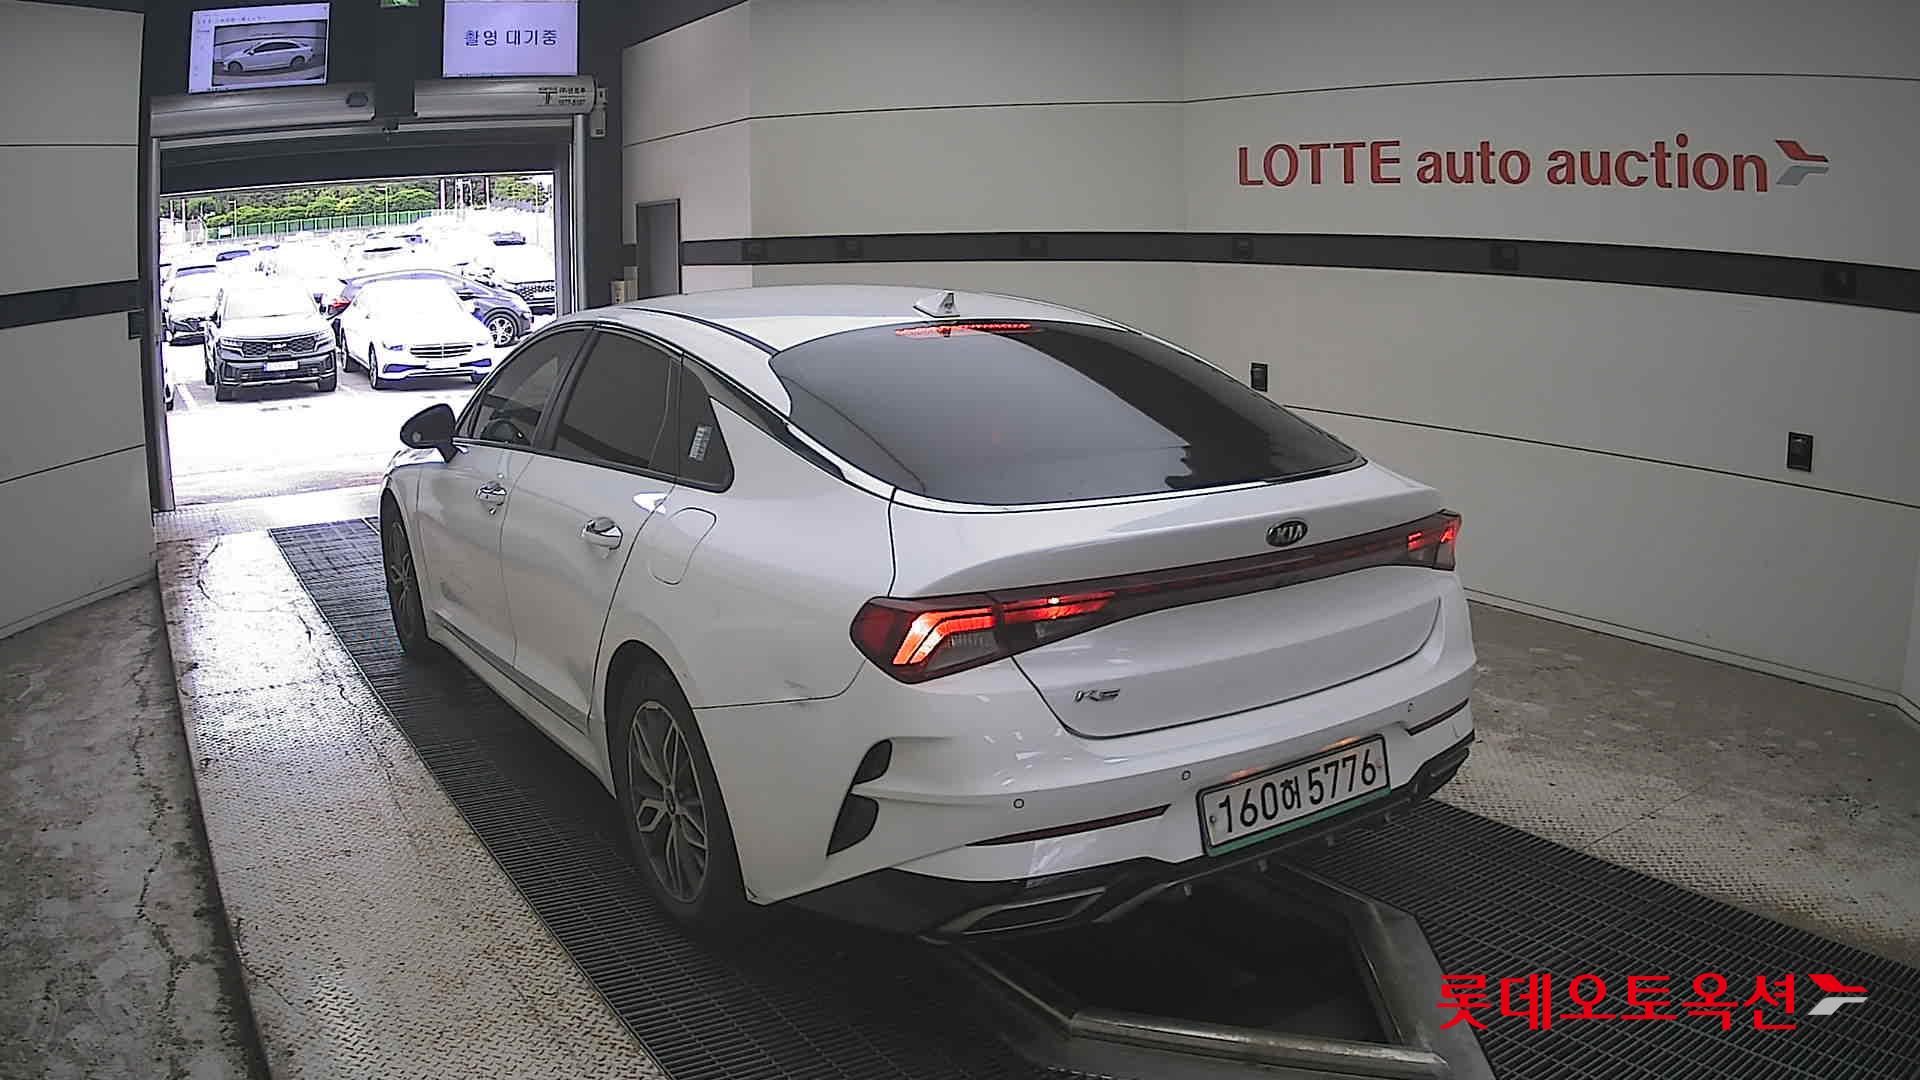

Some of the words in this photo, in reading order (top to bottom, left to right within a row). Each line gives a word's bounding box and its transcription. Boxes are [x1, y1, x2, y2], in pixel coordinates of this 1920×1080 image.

[505, 29, 558, 46] 대기중
[1239, 139, 1400, 187] LOTTE
[1417, 141, 1531, 185] auto
[1547, 134, 1768, 192] auction
